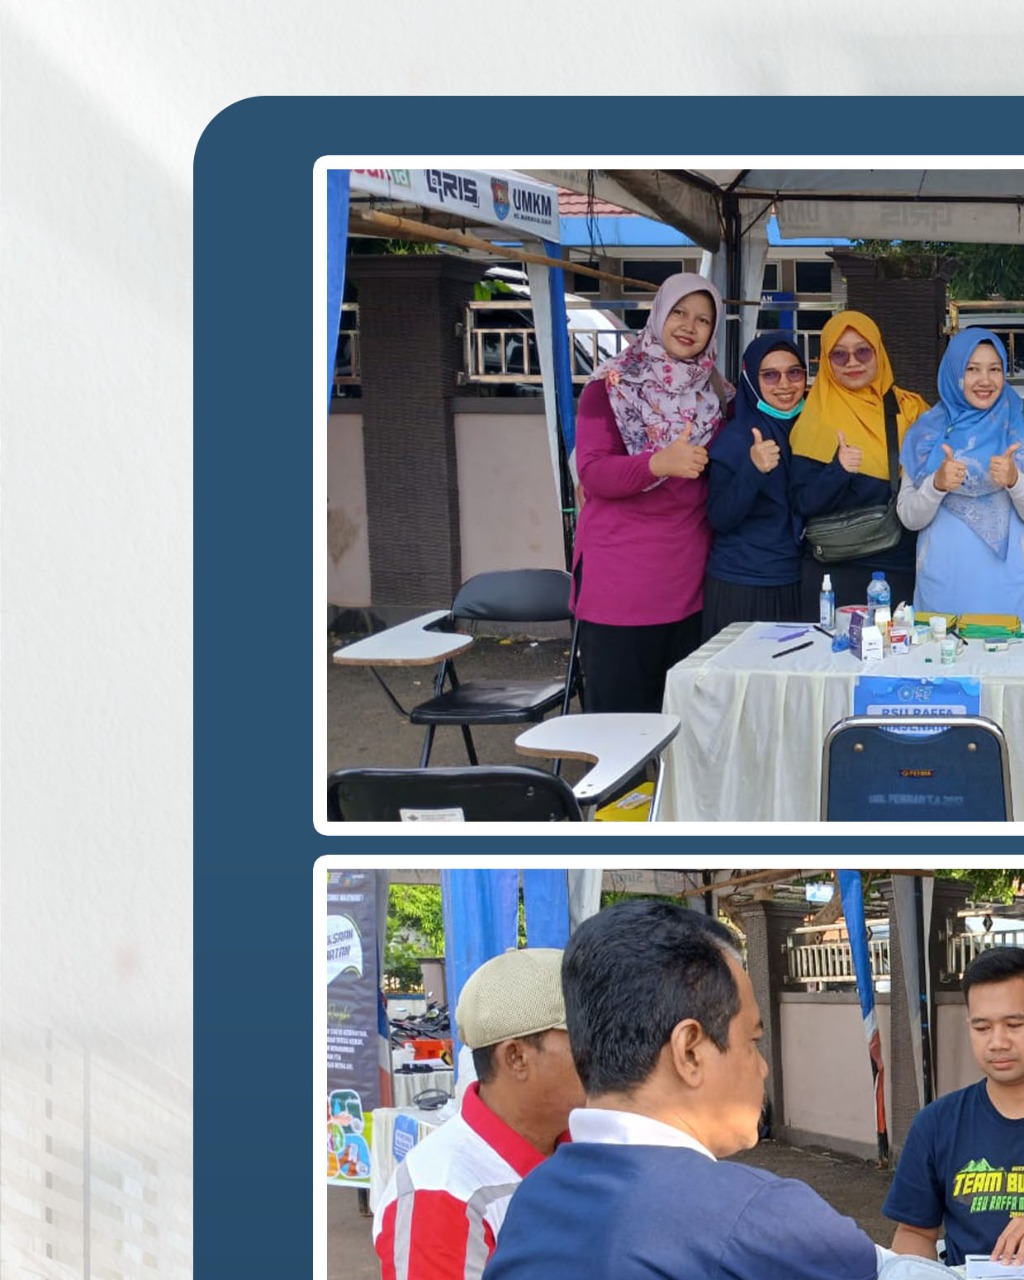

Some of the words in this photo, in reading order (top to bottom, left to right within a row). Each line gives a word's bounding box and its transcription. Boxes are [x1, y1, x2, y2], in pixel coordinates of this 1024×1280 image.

[425, 169, 479, 206] QRIS
[513, 188, 551, 217] UMKM
[953, 1172, 1003, 1197] TEAM
